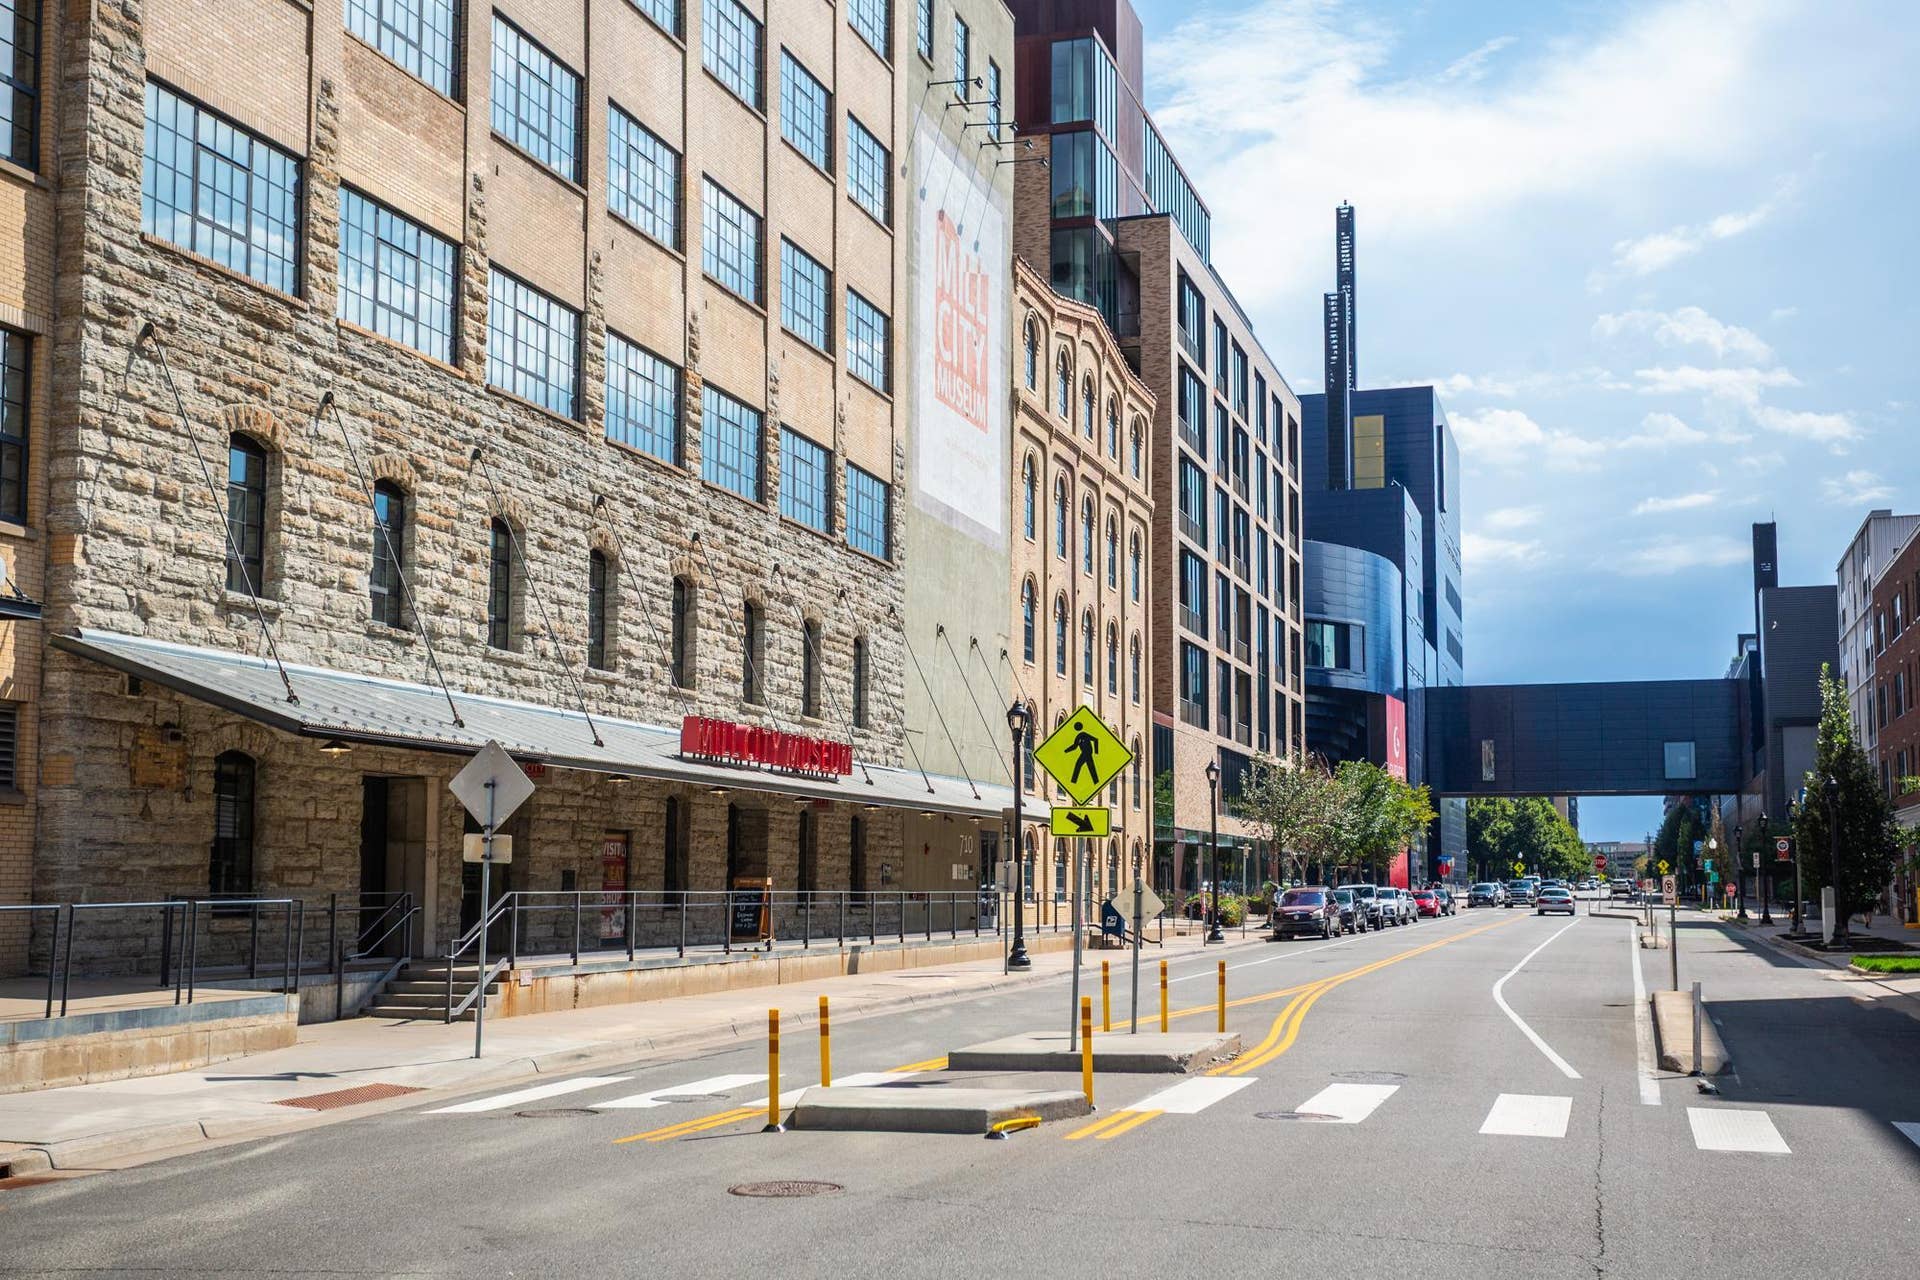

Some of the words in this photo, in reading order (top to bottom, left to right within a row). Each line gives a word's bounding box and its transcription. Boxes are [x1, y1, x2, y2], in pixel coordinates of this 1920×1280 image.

[937, 229, 988, 326] MILL
[937, 301, 986, 385] CITY
[936, 362, 987, 428] MUSEUM
[959, 835, 973, 856] 710
